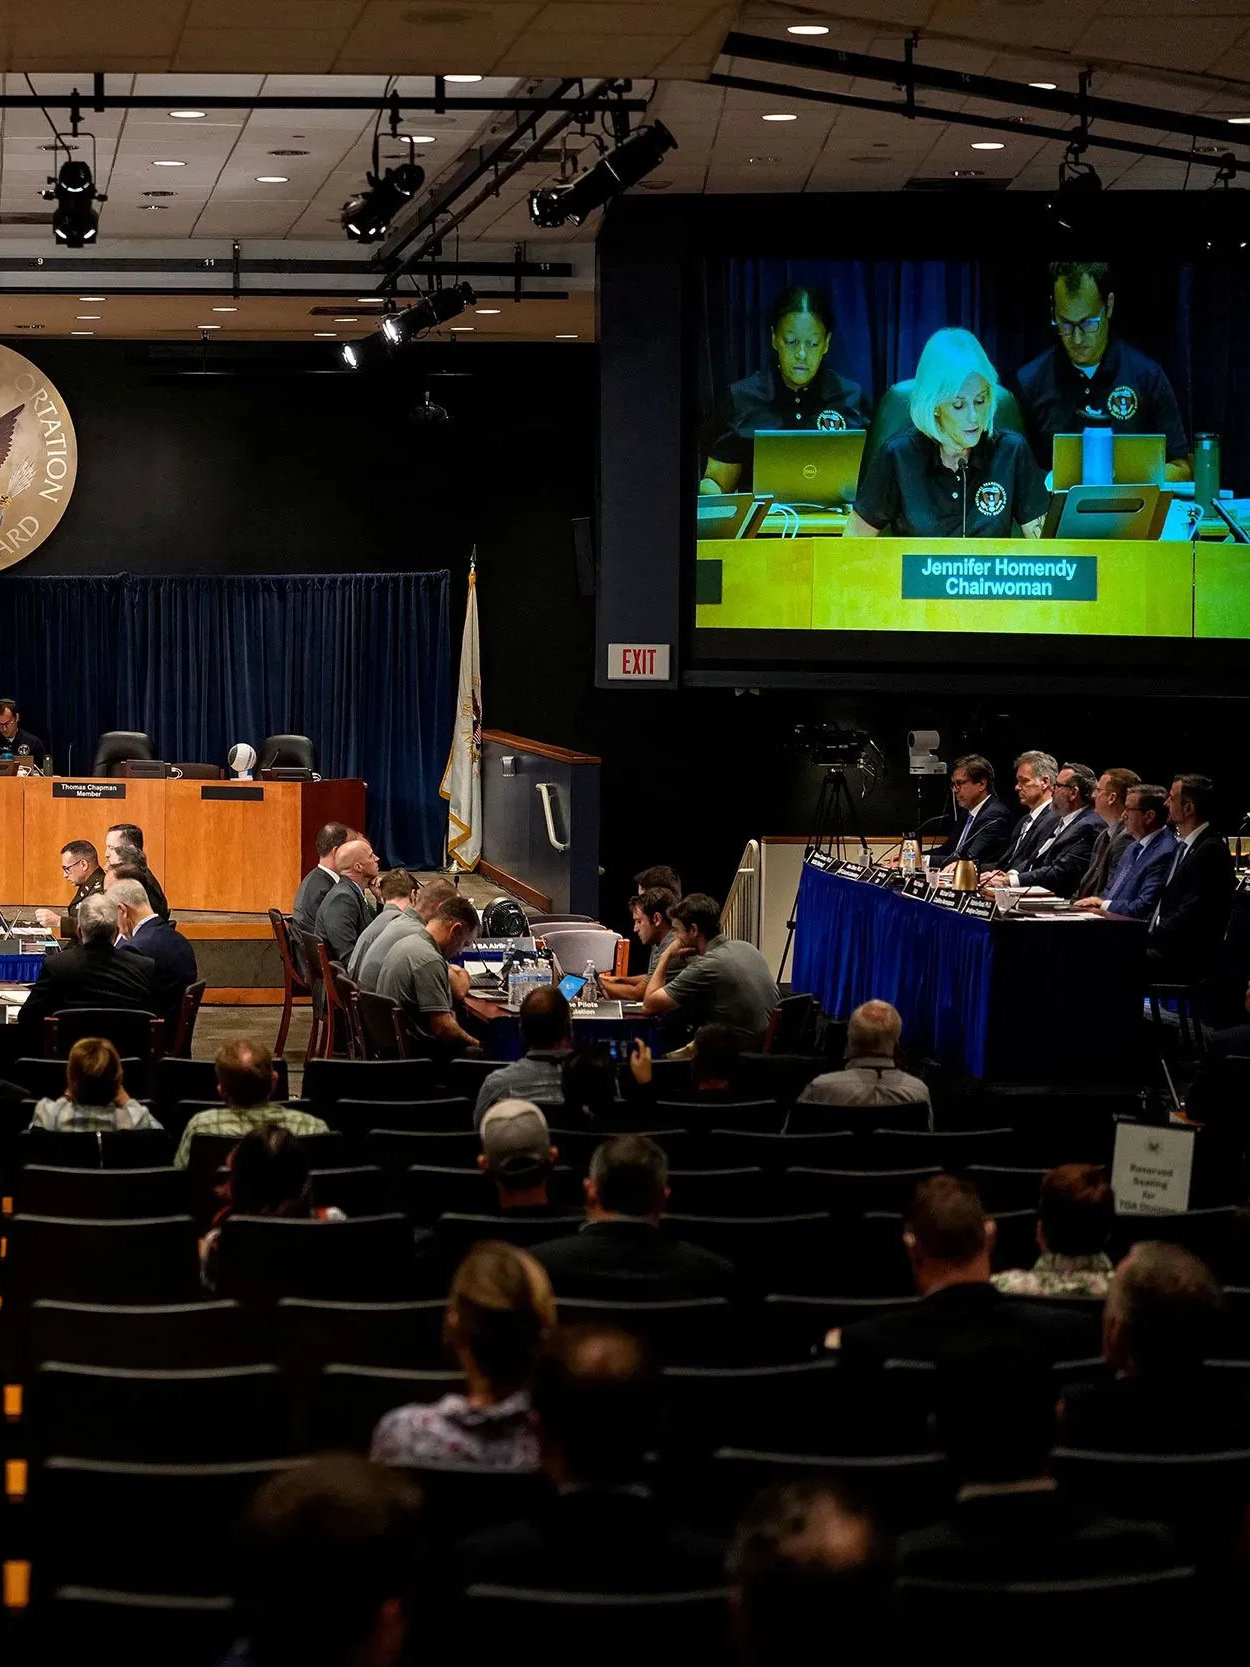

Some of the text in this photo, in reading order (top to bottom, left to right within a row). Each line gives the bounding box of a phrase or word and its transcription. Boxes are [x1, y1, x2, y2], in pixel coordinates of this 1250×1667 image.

[204, 258, 215, 266] 11
[921, 557, 1077, 581] Jennifer Homendy
[945, 577, 1052, 596] Chairwoman
[622, 648, 657, 675] EXIT
[87, 784, 117, 792] Chapman
